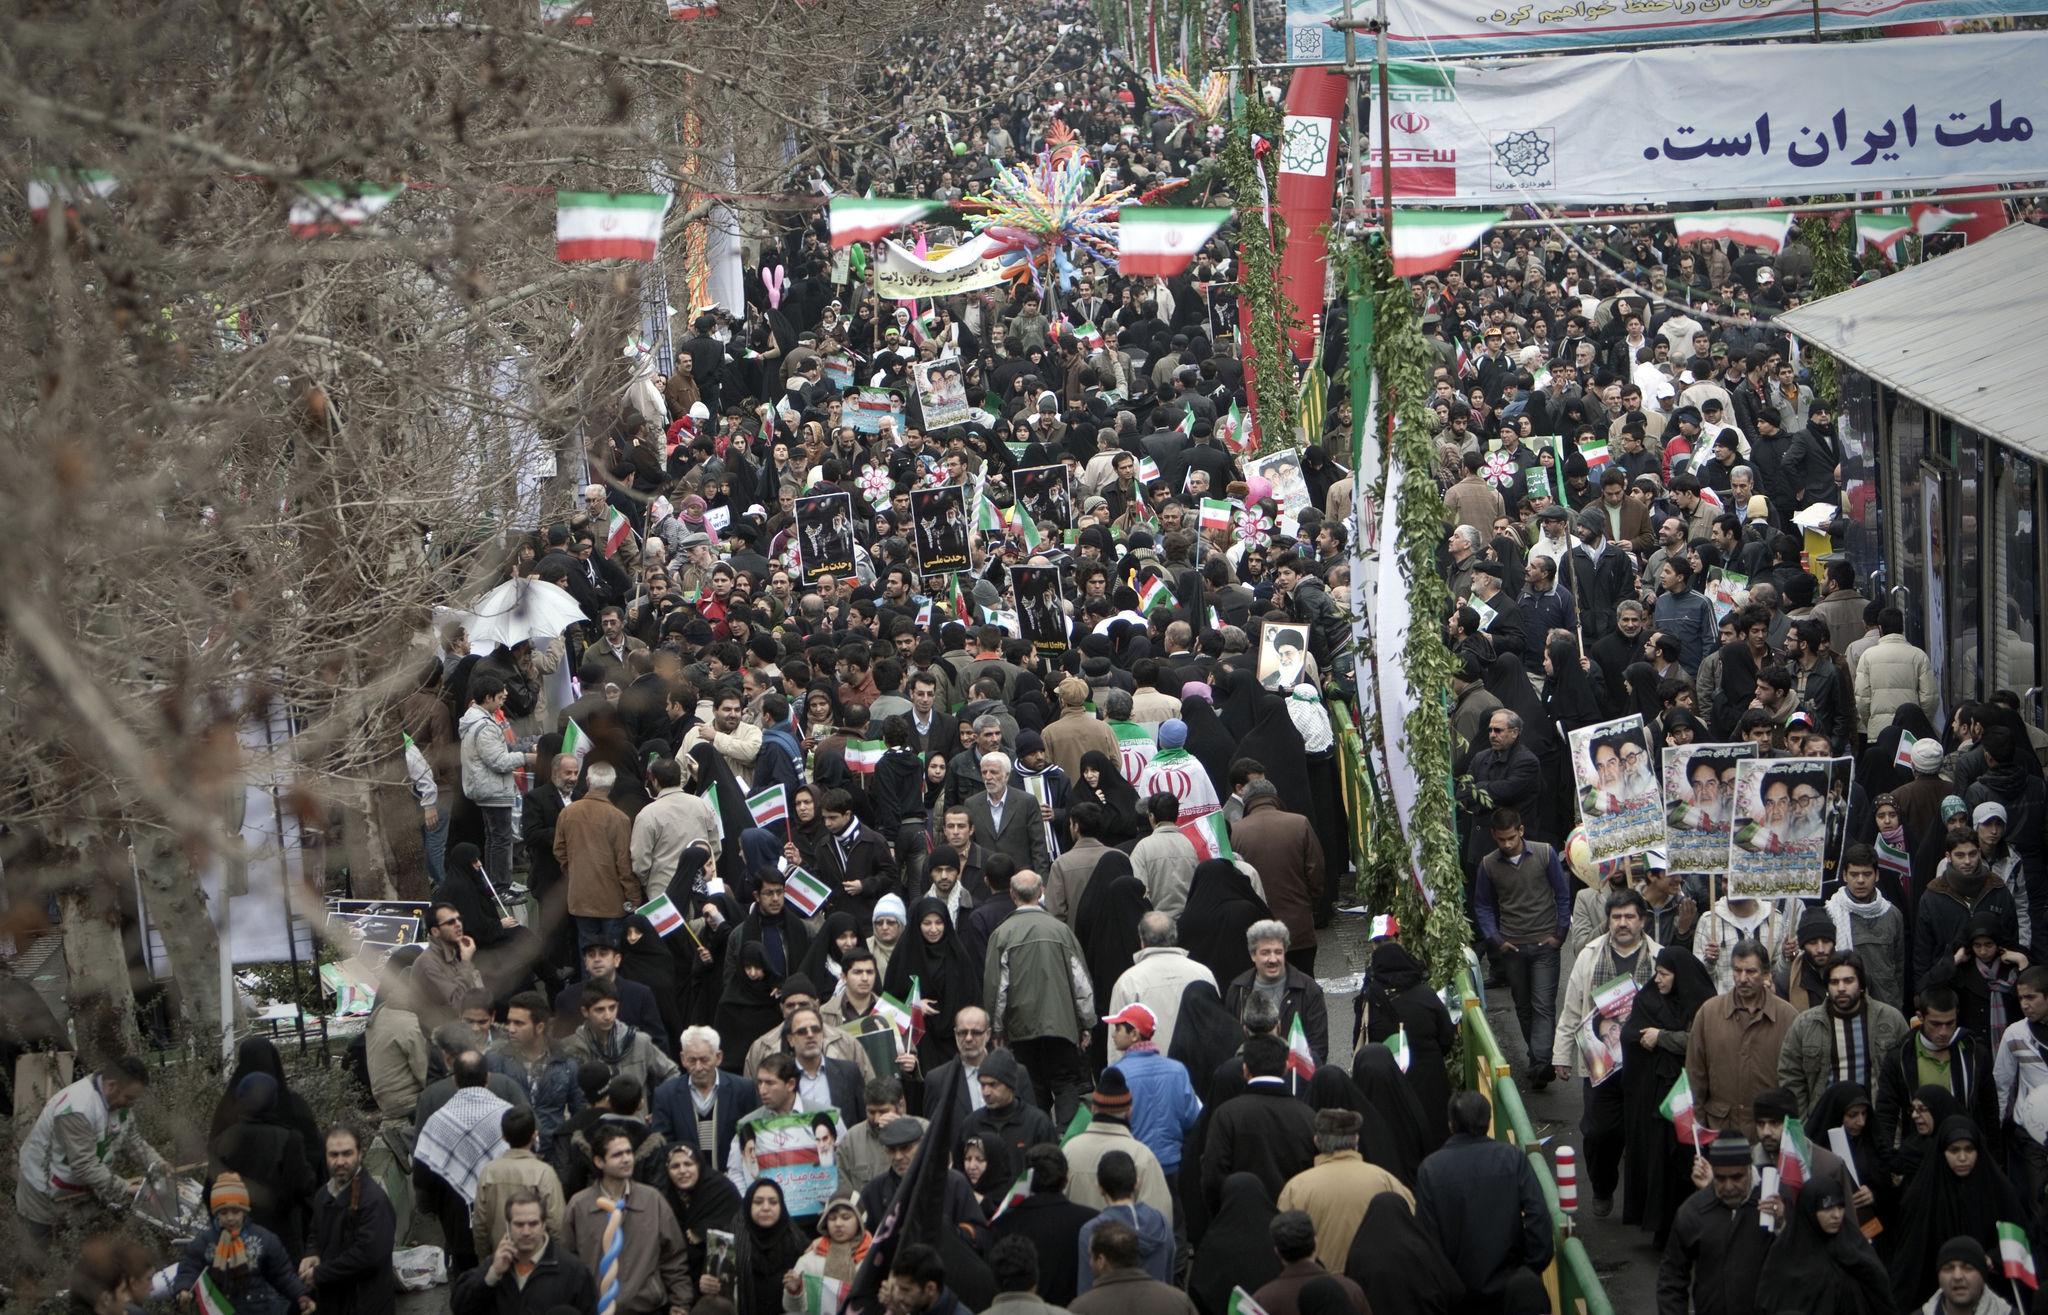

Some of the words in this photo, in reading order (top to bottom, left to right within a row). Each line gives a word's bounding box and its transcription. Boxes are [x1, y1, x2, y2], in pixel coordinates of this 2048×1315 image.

[1538, 0, 1616, 24] خواهیم
[1934, 98, 2034, 148] ملت
[1787, 104, 1917, 168] ایران
[1520, 180, 1552, 189] شهرداری
[880, 271, 905, 286] ولایت
[829, 561, 852, 571] وحدت
[924, 554, 943, 568] ملی
[944, 554, 967, 564] وحدت
[808, 562, 830, 576] ملی
